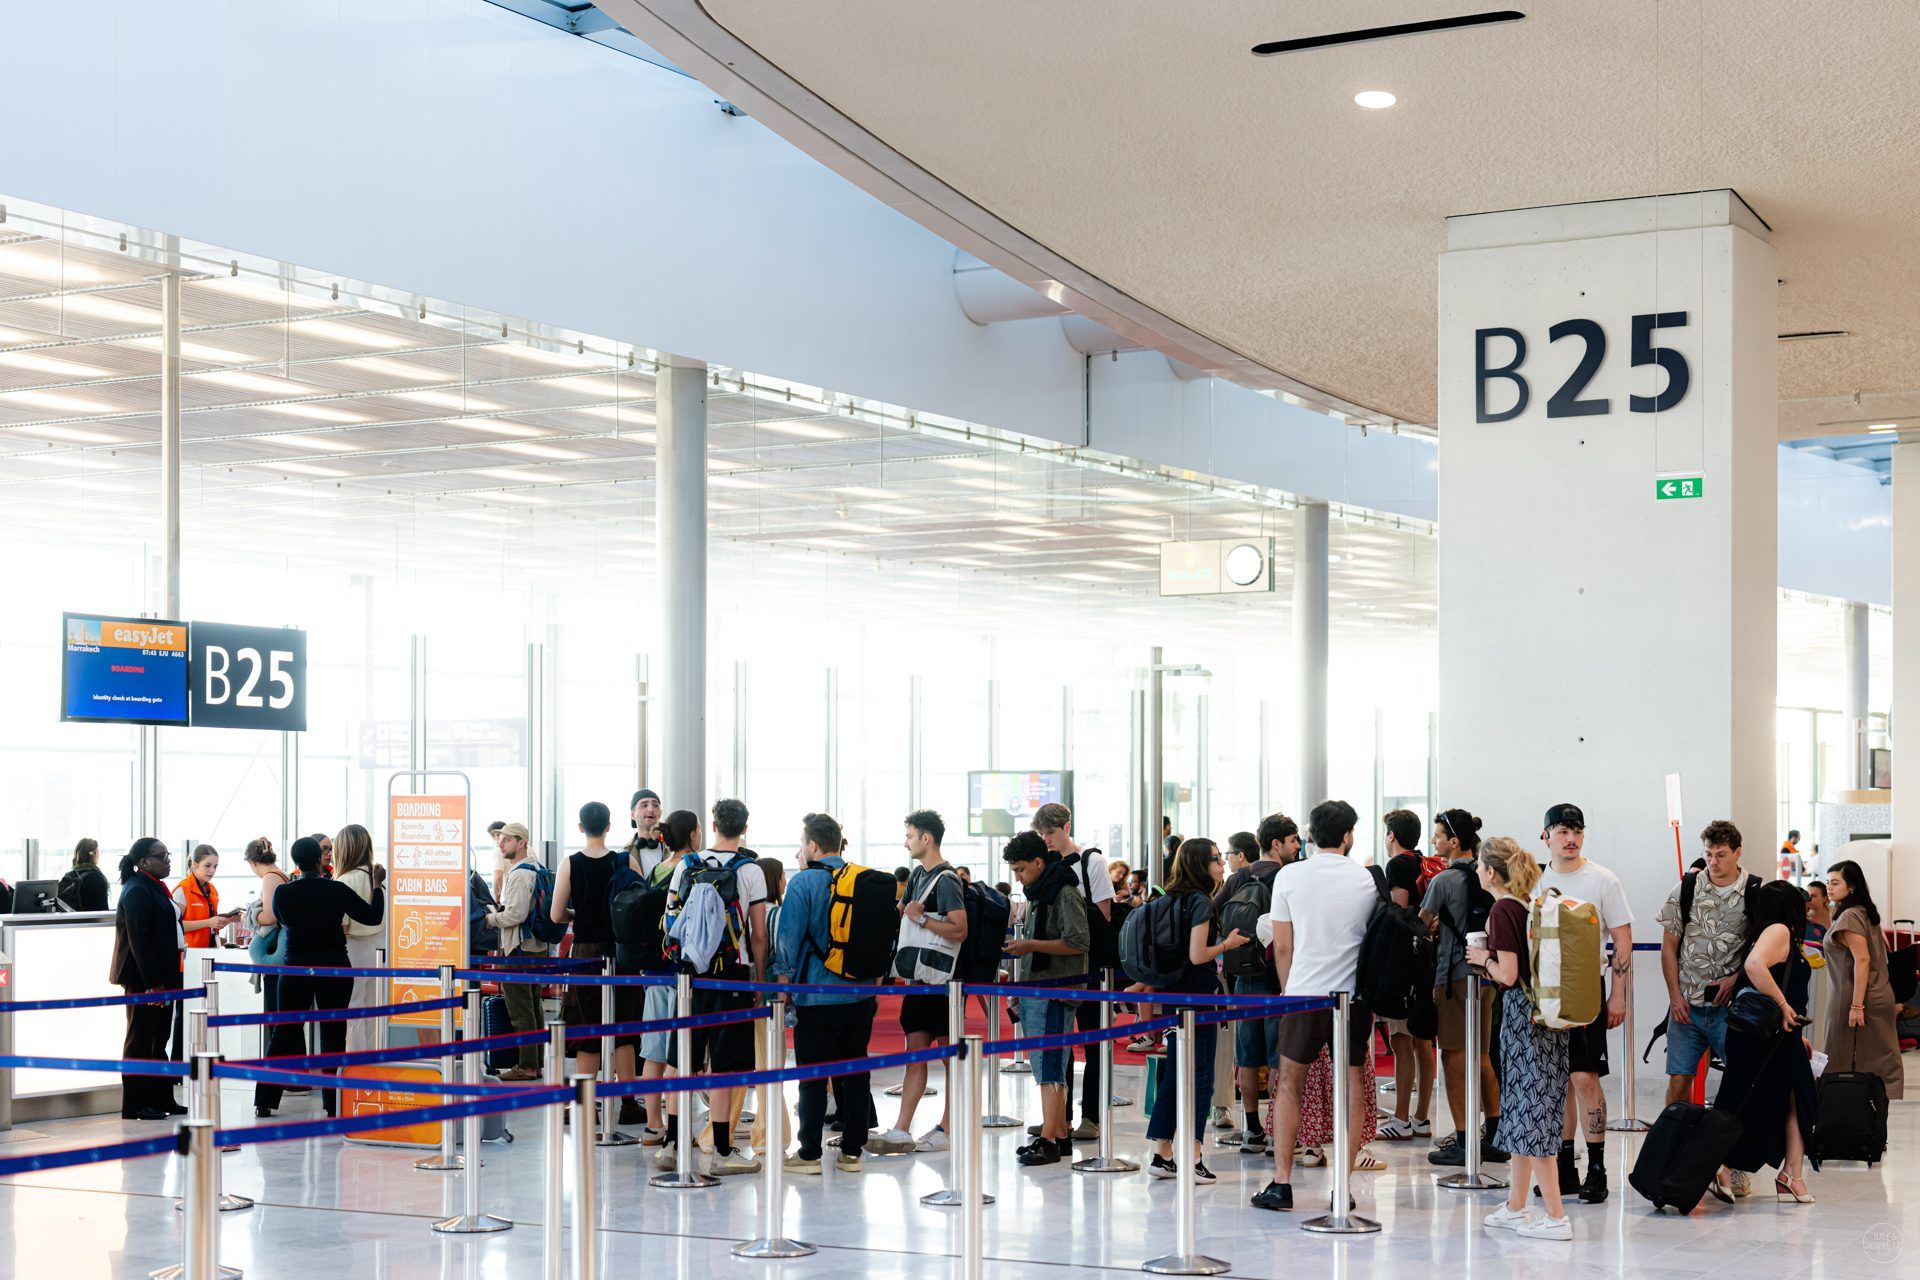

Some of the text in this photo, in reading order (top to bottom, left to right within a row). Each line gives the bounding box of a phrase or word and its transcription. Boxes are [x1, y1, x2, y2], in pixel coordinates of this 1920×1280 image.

[1475, 311, 1690, 424] B25
[114, 627, 173, 646] easyJet
[67, 644, 100, 653] Marrakech
[111, 664, 145, 674] BOARDING
[205, 645, 294, 709] B25
[92, 694, 111, 702] Identity
[397, 802, 442, 817] BOARDING
[401, 822, 424, 831] Speedy
[401, 832, 431, 840] Boarding
[424, 848, 452, 857] All other
[396, 878, 448, 893] CABIN BAGS
